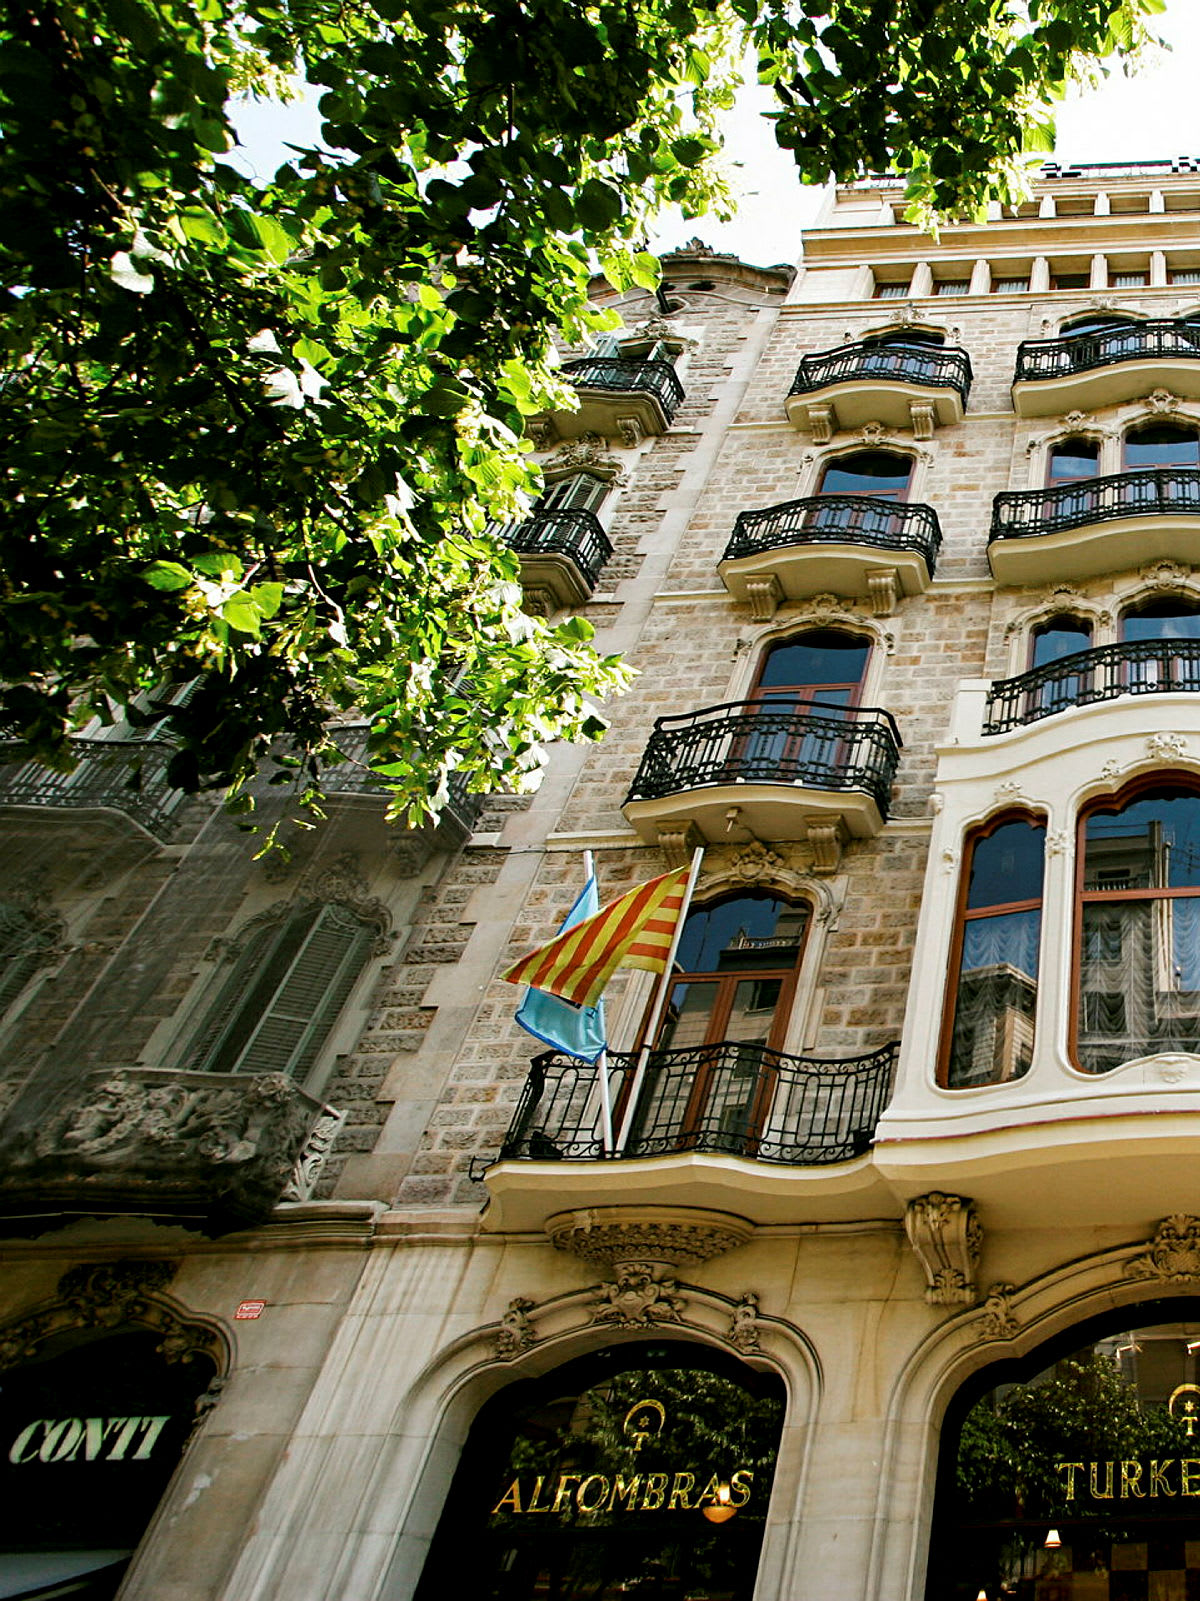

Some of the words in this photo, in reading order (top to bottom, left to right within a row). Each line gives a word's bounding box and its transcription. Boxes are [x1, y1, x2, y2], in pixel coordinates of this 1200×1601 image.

[9, 1416, 172, 1464] CONTI
[1181, 1416, 1198, 1436] T
[491, 1470, 754, 1514] ALFOMBRAS
